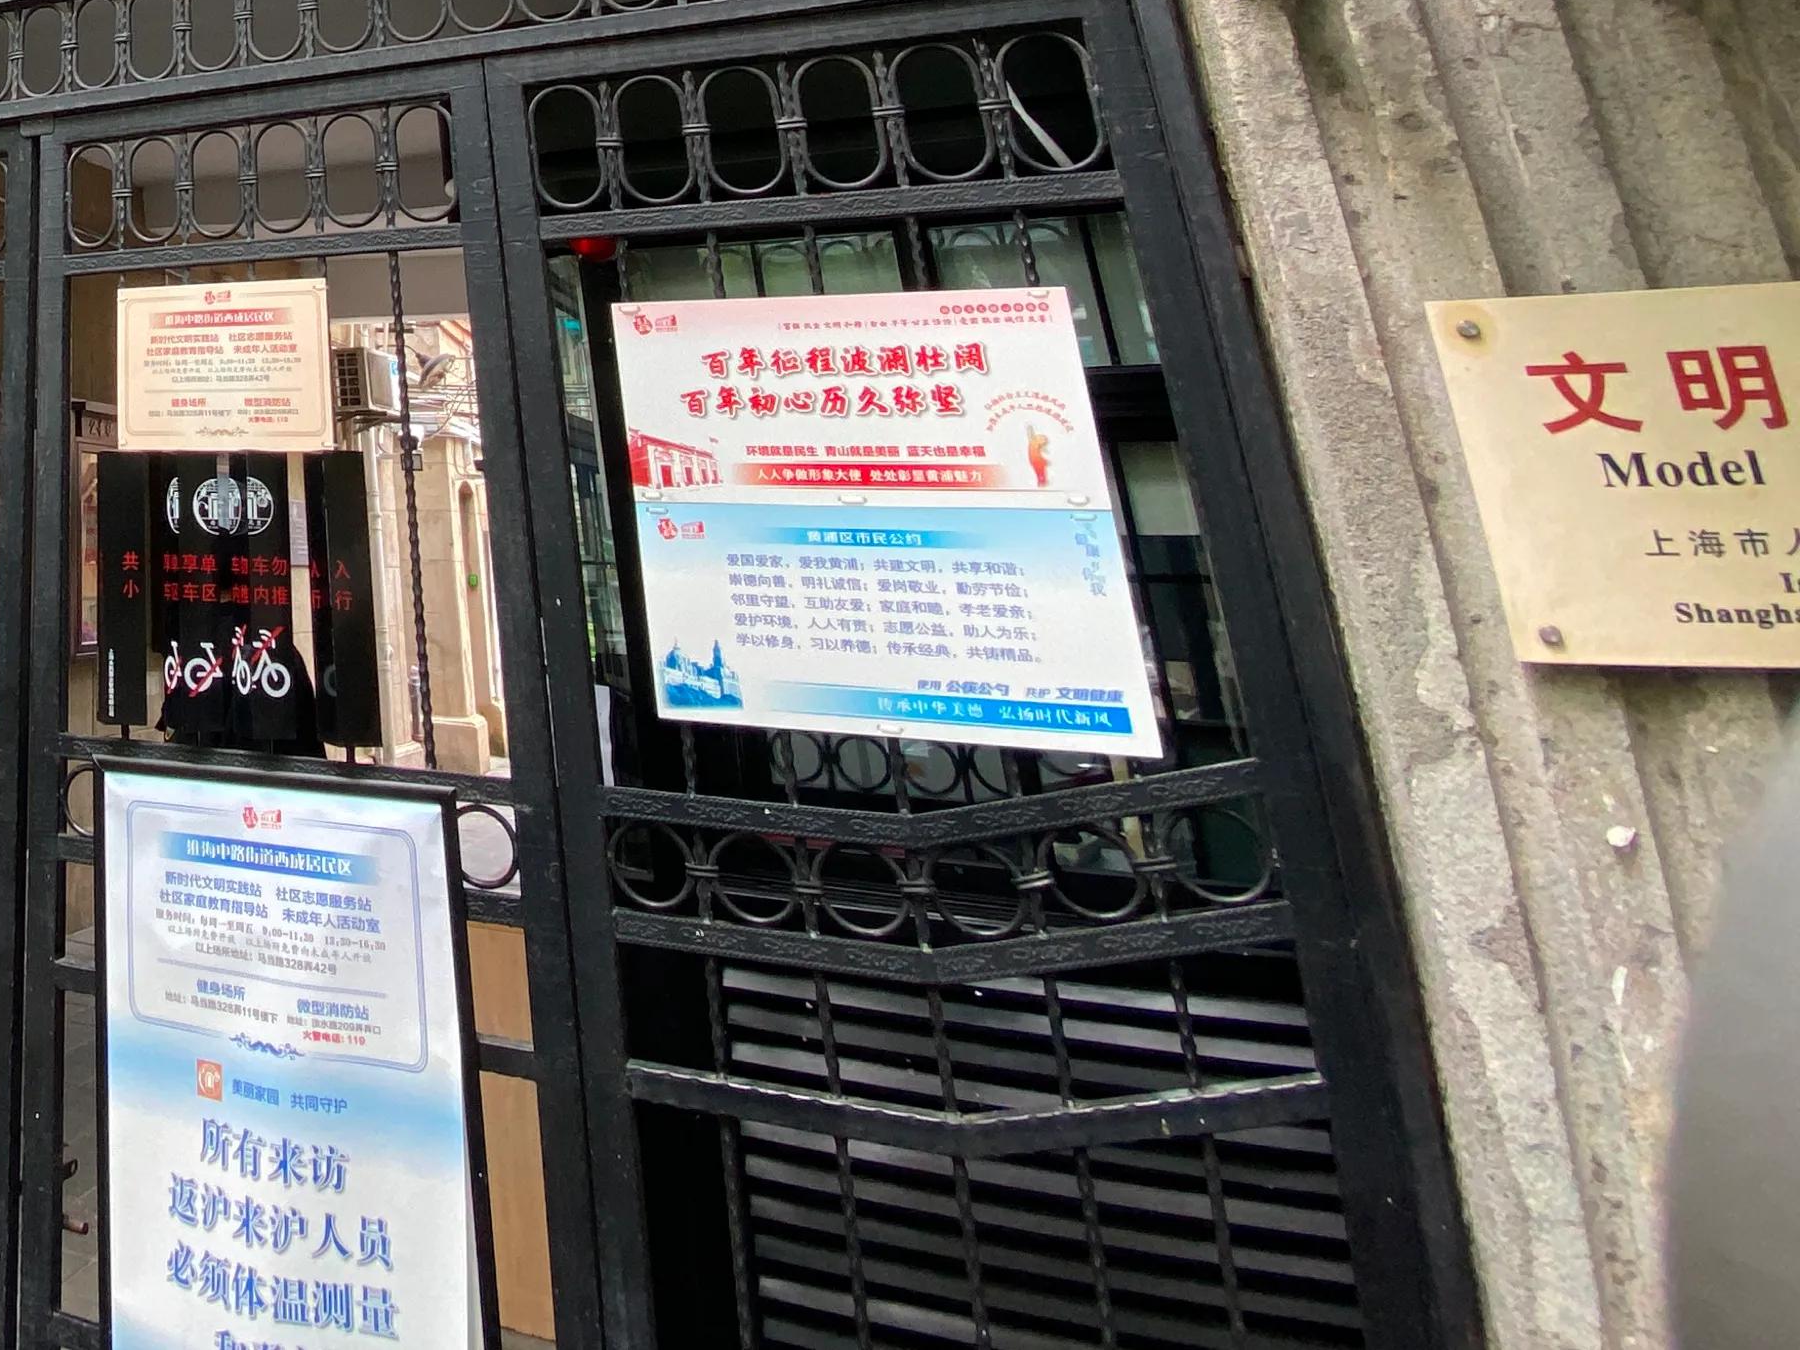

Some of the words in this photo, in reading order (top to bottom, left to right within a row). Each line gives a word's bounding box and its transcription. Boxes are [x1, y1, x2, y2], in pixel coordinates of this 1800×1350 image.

[701, 342, 988, 380] 百年征程波澜壮阔
[680, 384, 964, 419] 百年初心历久弥坚
[1525, 345, 1789, 434] 文明
[1596, 450, 1766, 488] Model
[807, 530, 922, 546] 黄浦区市民公约
[165, 871, 262, 897] 新时代文明实践站
[276, 886, 372, 912] 社区志愿服务站
[159, 890, 268, 918] 社区家庭教育指导站
[282, 907, 381, 933] 未成年人活动室
[197, 978, 246, 1001] 健身场所
[297, 999, 369, 1021] 微型消防站
[232, 1078, 280, 1106] 美丽家园
[290, 1092, 348, 1114] 共同守护
[201, 1118, 351, 1193] 所有来访
[168, 1172, 394, 1271] 返沪来沪人员
[167, 1239, 400, 1340] 必须体温测量
